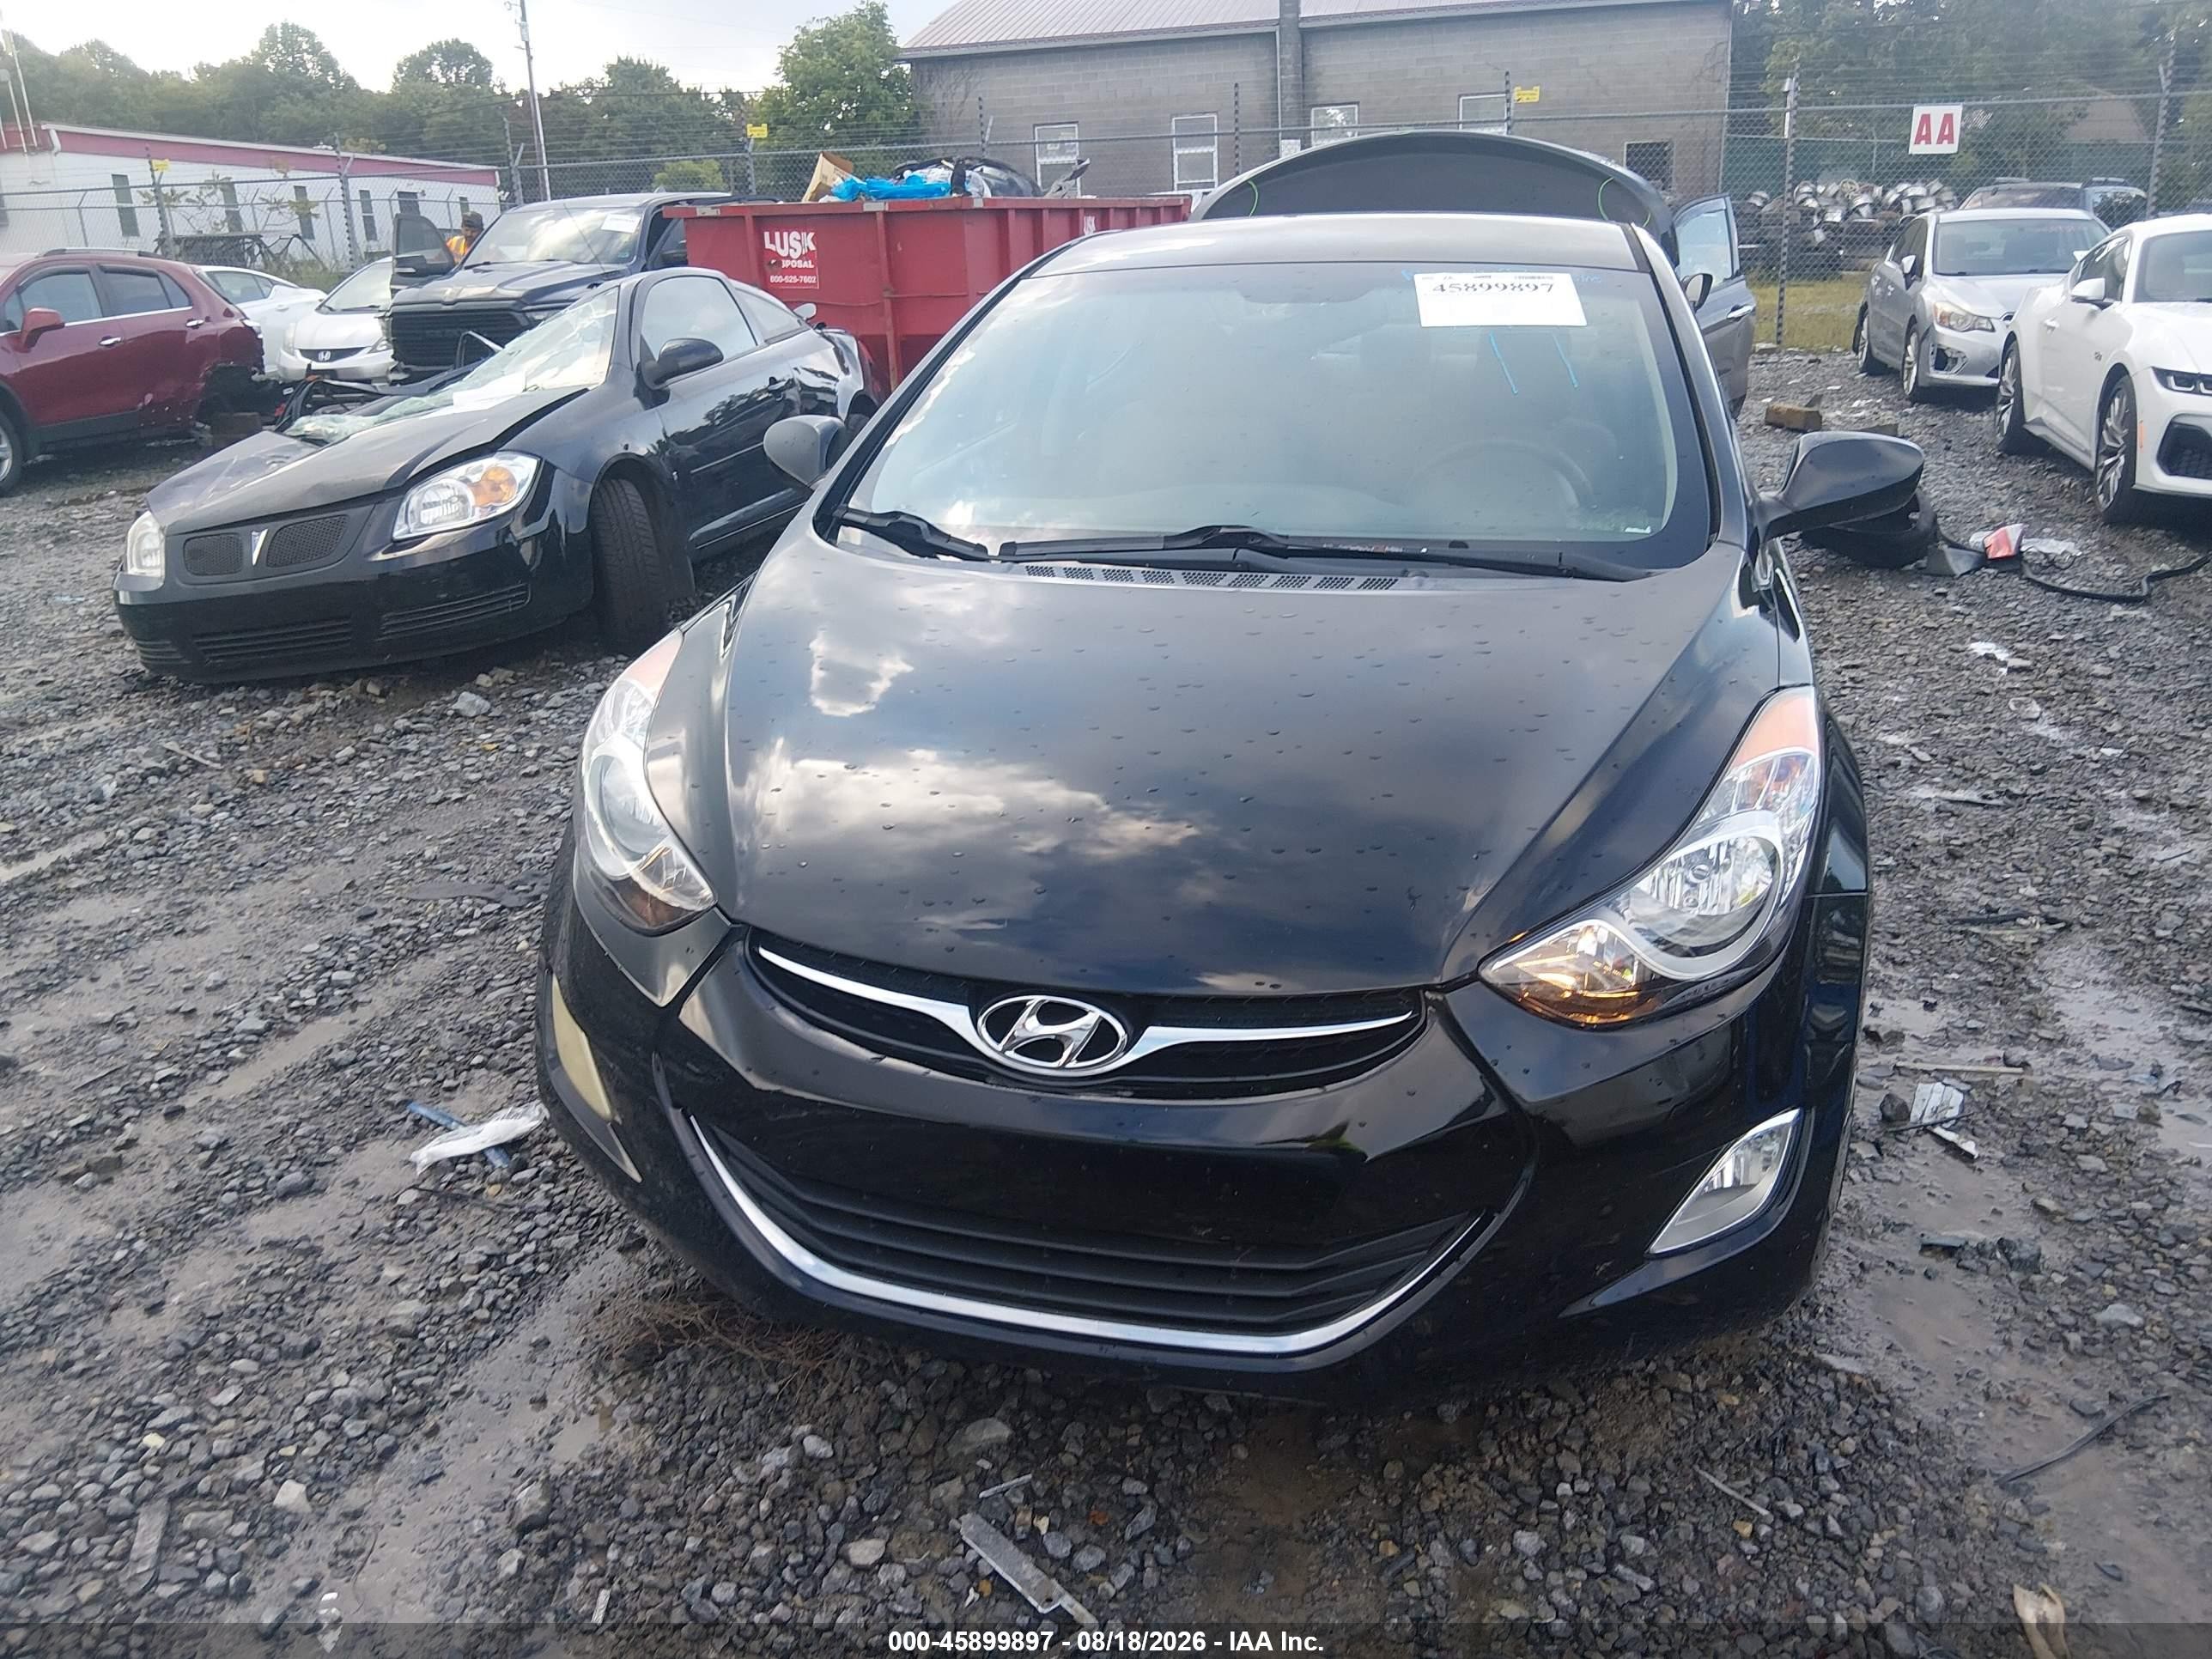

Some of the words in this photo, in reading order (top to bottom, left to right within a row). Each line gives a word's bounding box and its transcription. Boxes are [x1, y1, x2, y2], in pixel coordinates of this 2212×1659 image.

[1914, 113, 1954, 144] AA
[763, 230, 817, 259] LUSK
[1431, 282, 1555, 294] 45899897
